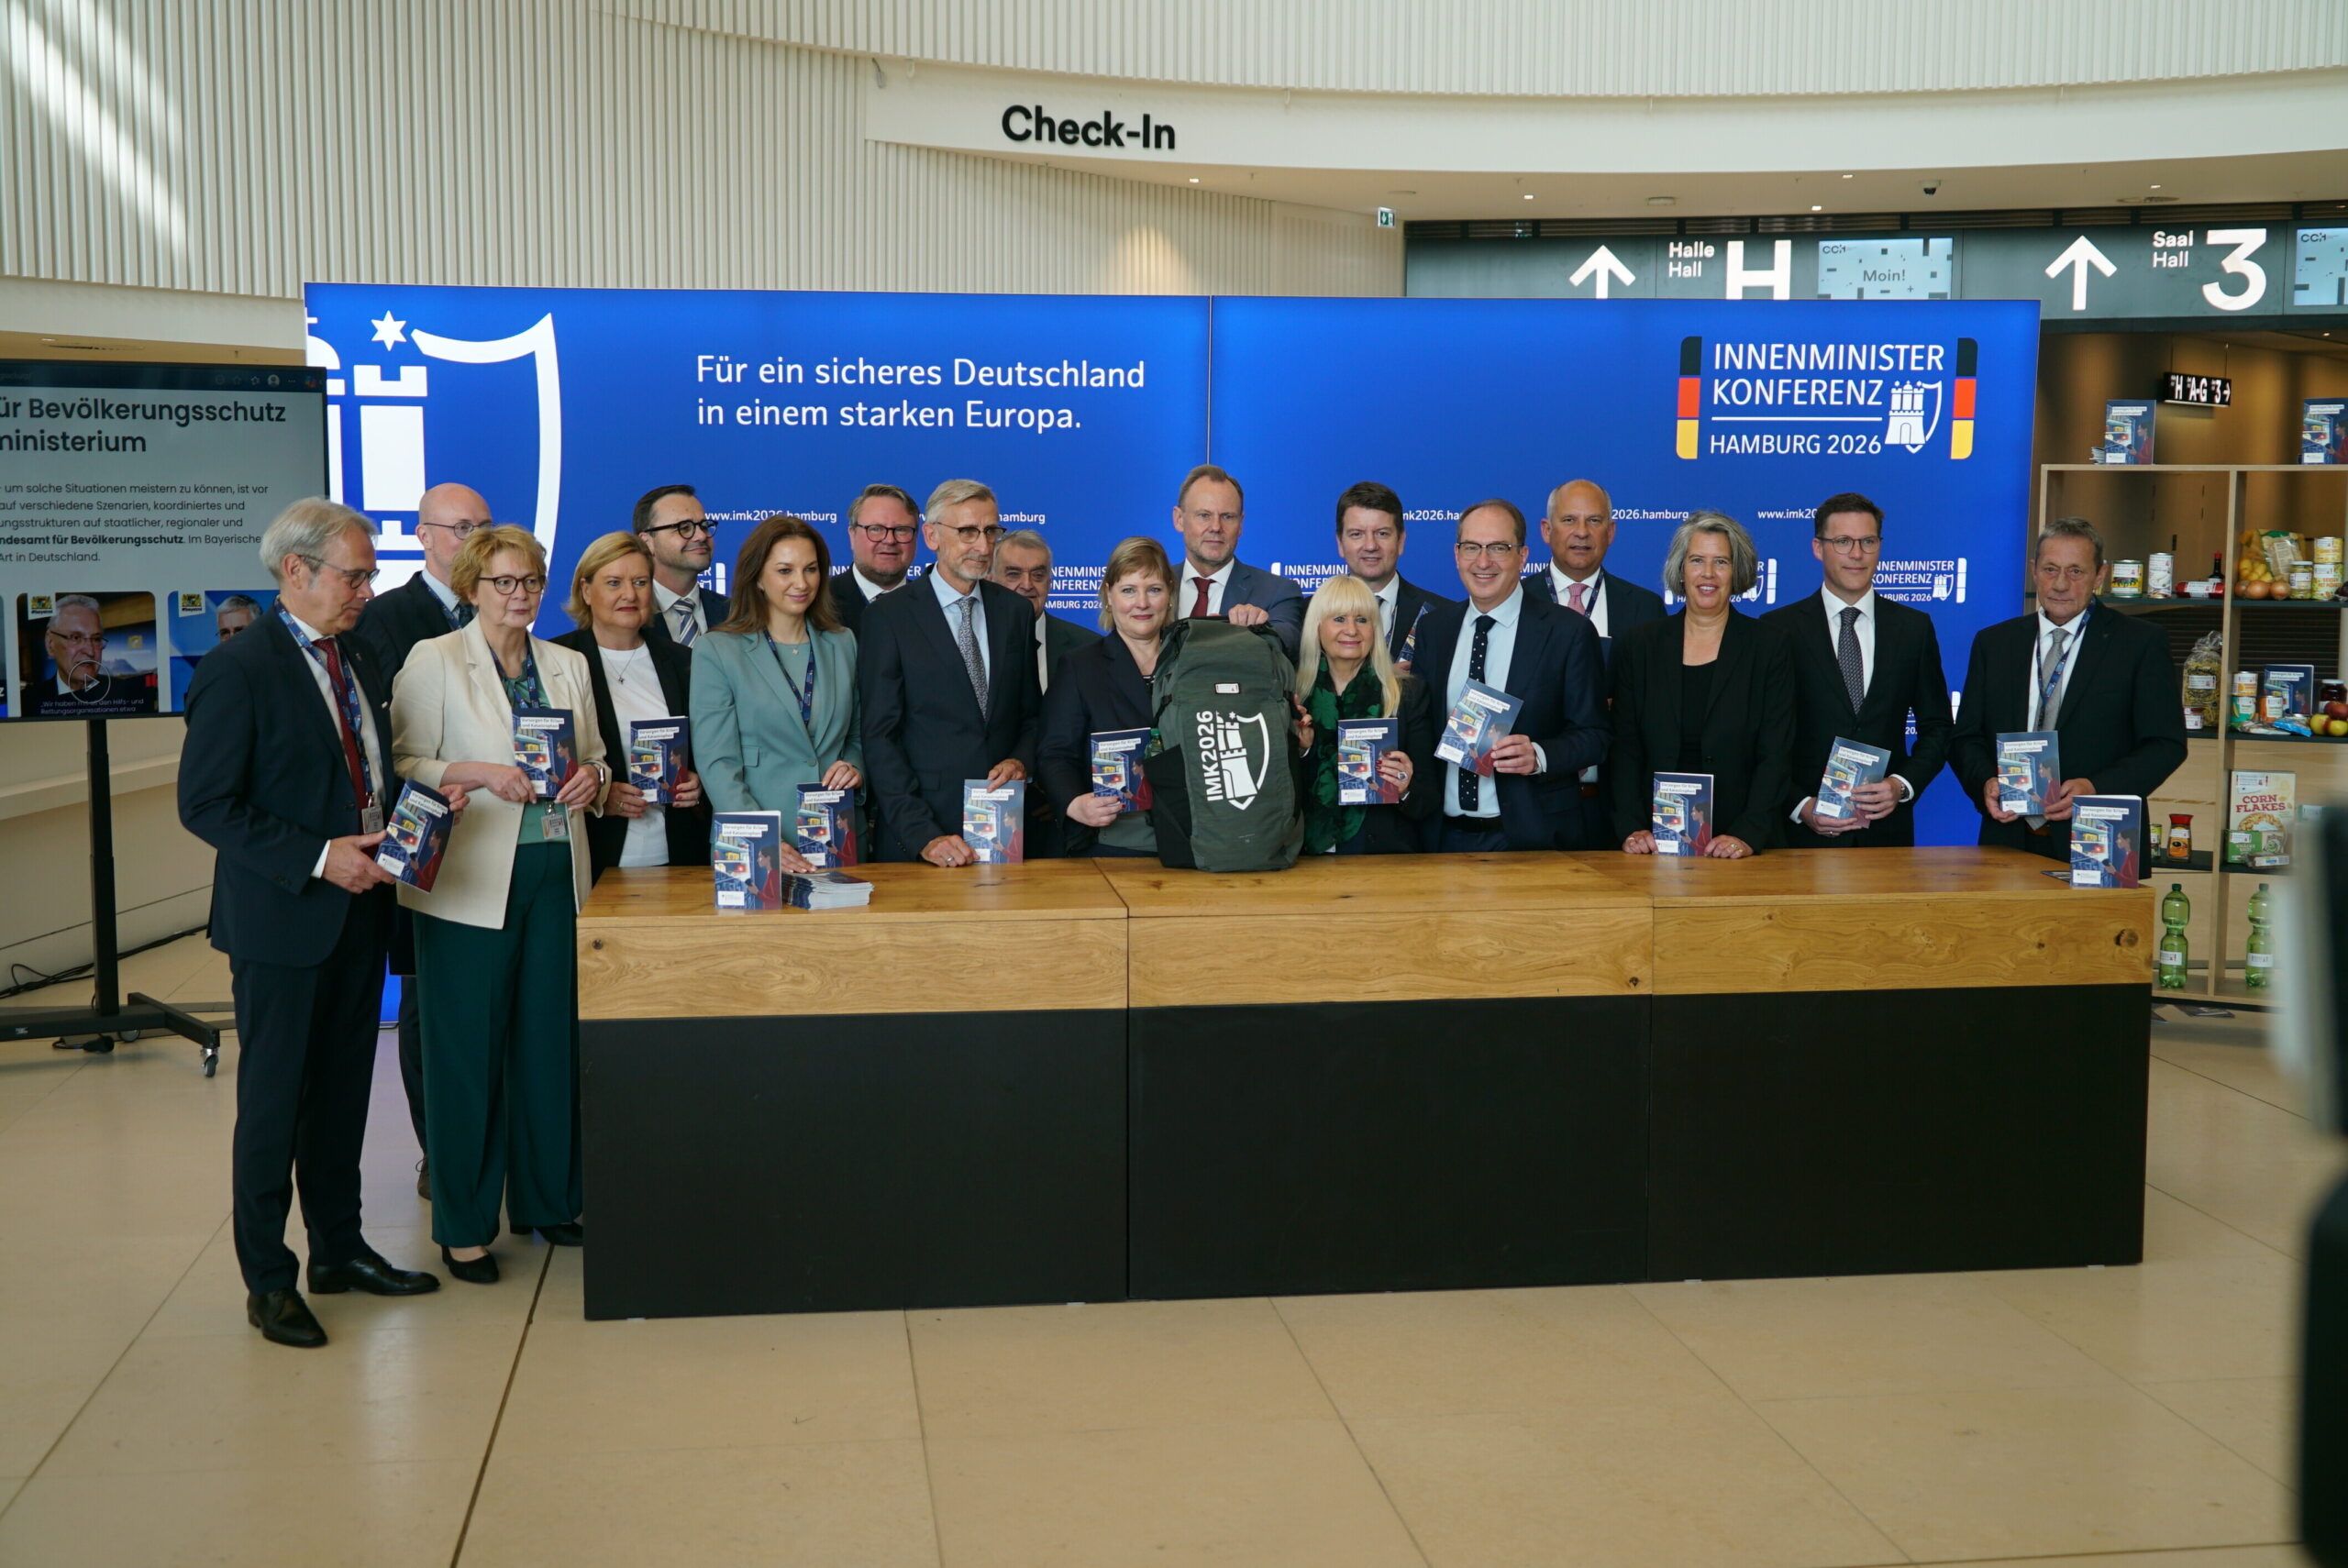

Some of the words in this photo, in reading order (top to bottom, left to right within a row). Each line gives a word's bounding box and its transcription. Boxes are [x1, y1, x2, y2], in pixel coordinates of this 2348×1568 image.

[1002, 105, 1176, 149] Check-In
[2153, 230, 2194, 248] Saal
[1668, 241, 1715, 258] Halle
[2153, 250, 2189, 268] Hall
[1668, 260, 1702, 278] Hall
[1726, 239, 1791, 300] H
[1863, 269, 1906, 282] Moin!
[2202, 228, 2267, 311] 3
[1714, 343, 1944, 370] INNENMINISTER
[697, 355, 748, 383] Für
[759, 357, 802, 383] ein
[815, 358, 943, 386] sicheres
[954, 359, 1146, 388] Deutschland
[1713, 378, 1883, 405] KONFERENZ
[29, 397, 286, 428] Bevölkerungsschutz
[698, 399, 724, 425] in
[737, 400, 827, 426] einem
[839, 399, 955, 428] starken
[967, 401, 1082, 435] Europa.
[1711, 435, 1821, 455] HAMBURG
[1827, 435, 1882, 455] 2026
[5, 485, 23, 493] um
[26, 483, 62, 493] solche
[65, 483, 127, 493] Situationen
[129, 483, 177, 493] meistern
[179, 485, 191, 493] zu
[194, 483, 236, 495] können,
[238, 483, 249, 493] ist
[252, 485, 269, 493] vor
[19, 501, 94, 510] verschiedene
[96, 501, 150, 512] Szenarien,
[153, 501, 222, 511] koordiniertes
[225, 501, 245, 510] und
[83, 517, 102, 527] auf
[104, 517, 163, 528] staatlicher,
[166, 518, 220, 530] regionaler
[223, 518, 243, 527] und
[52, 535, 69, 545] für
[188, 535, 201, 544] Im
[16, 552, 26, 562] in
[29, 552, 101, 562] Deutschland.
[1911, 593, 1932, 602] 2026
[1196, 710, 1224, 801] IMK2026
[2235, 802, 2287, 812] FLAKES
[2242, 794, 2277, 804] CORN
